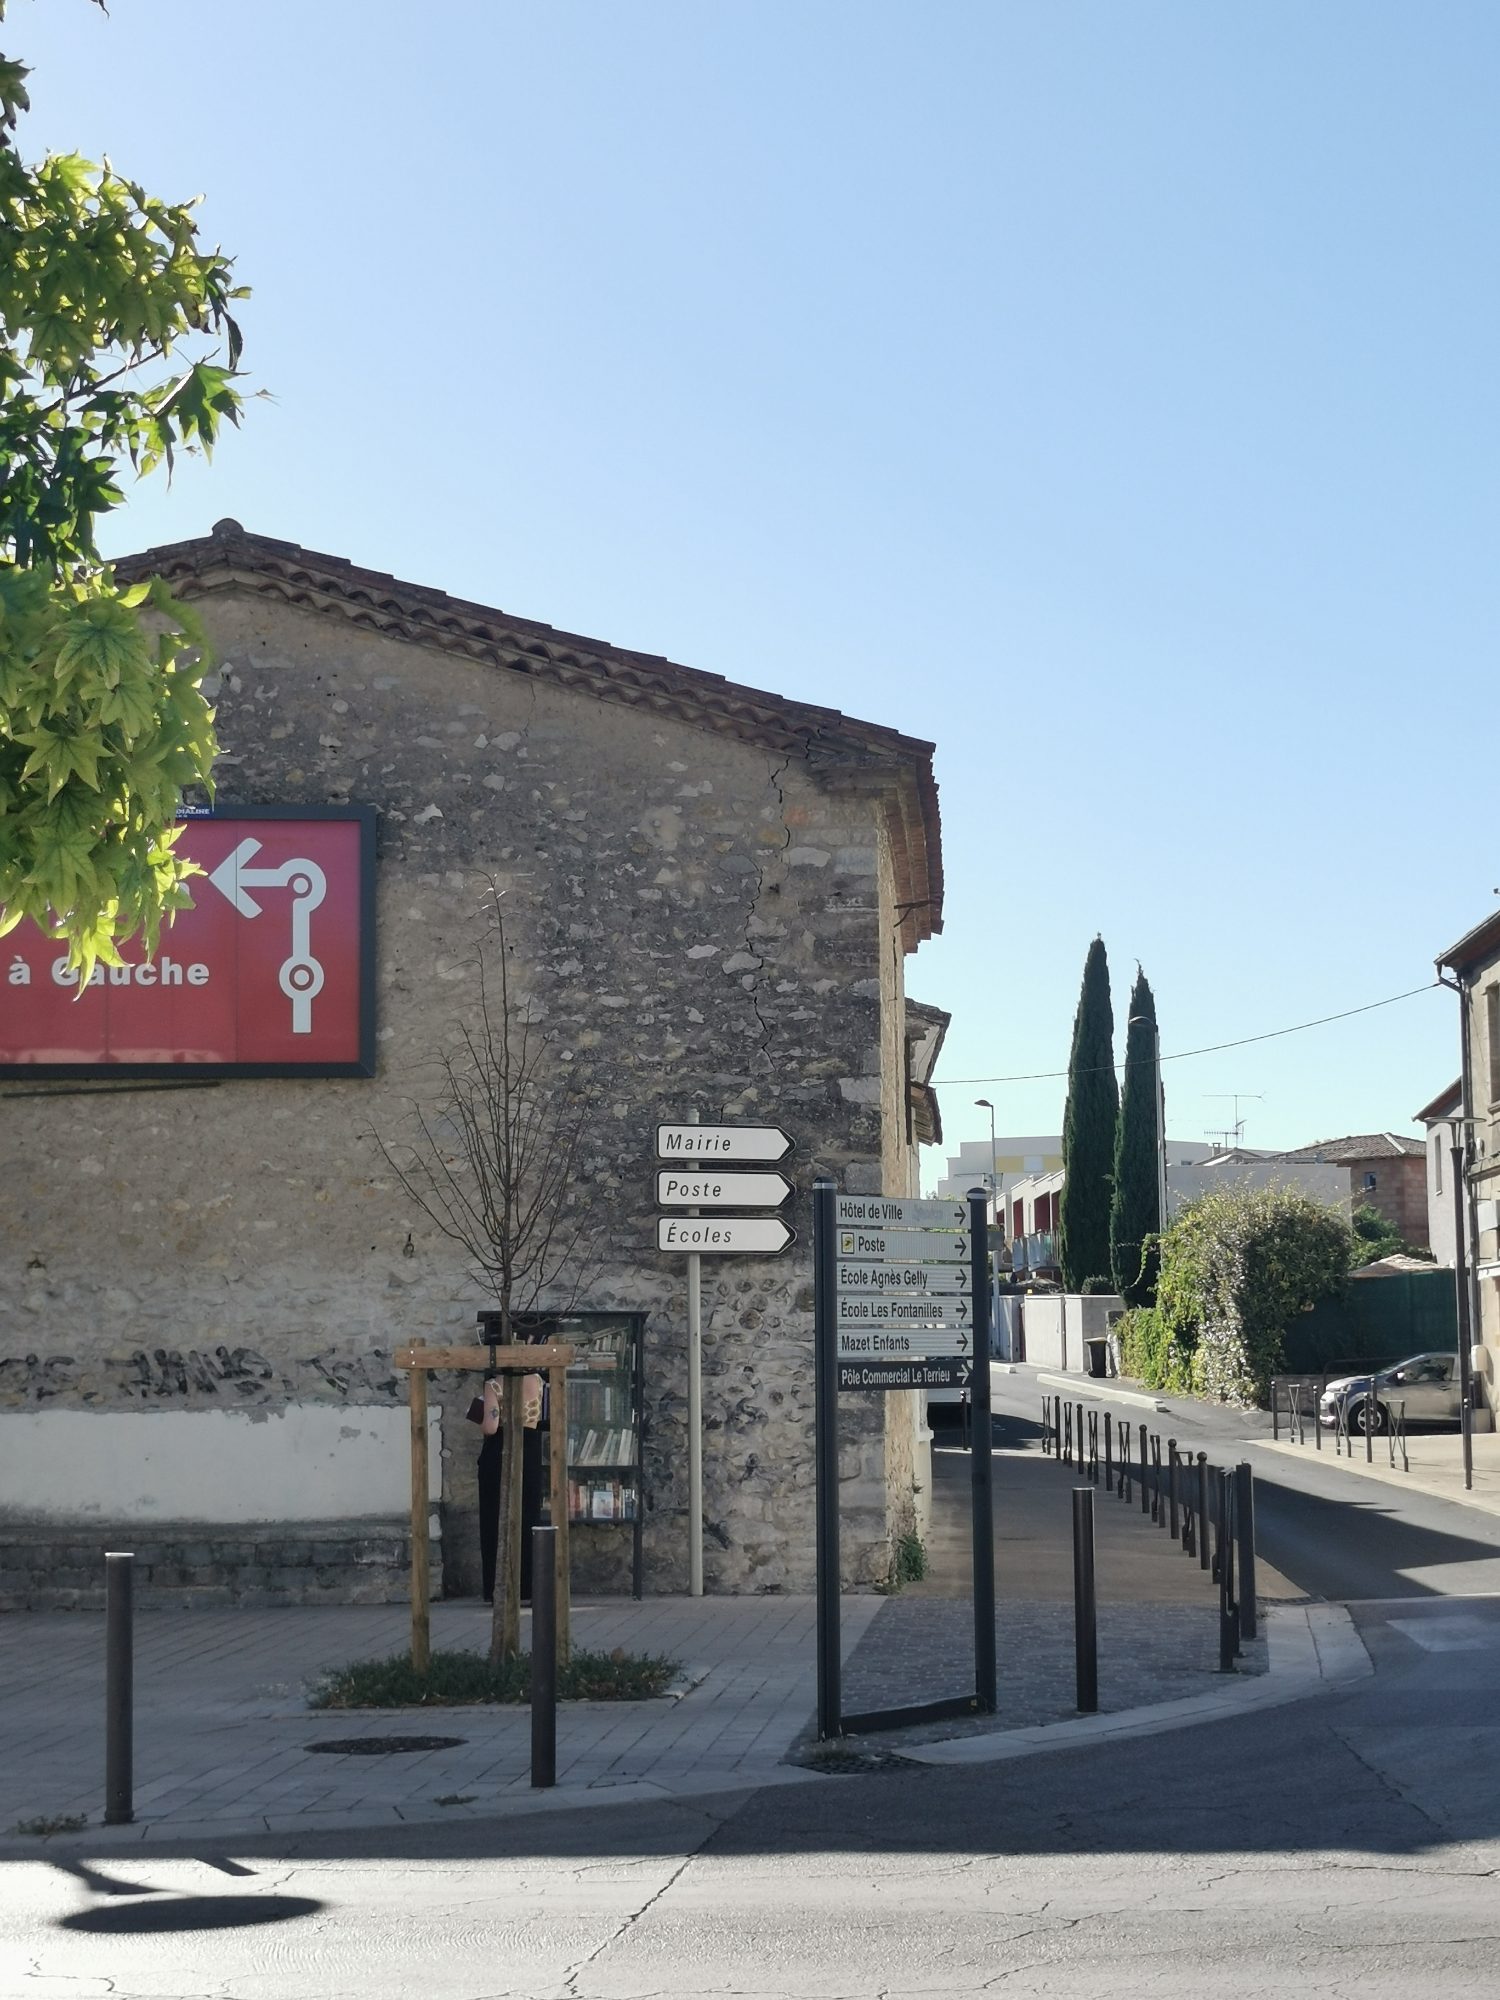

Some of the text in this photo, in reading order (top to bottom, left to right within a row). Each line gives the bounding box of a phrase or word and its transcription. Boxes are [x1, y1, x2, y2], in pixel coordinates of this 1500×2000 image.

[8, 955, 31, 985] à
[666, 1134, 731, 1151] Mairie
[666, 1181, 722, 1197] Poste
[839, 1202, 903, 1220] Hôtel de Ville
[667, 1222, 732, 1243] Écoles
[858, 1236, 885, 1252] Poste
[841, 1265, 928, 1289] École Agnès Gelly
[841, 1298, 943, 1318] École Les Fontanilles
[842, 1335, 910, 1351] Mazet Enfants
[842, 1367, 950, 1385] Pôle Commercial Le Terrieu
